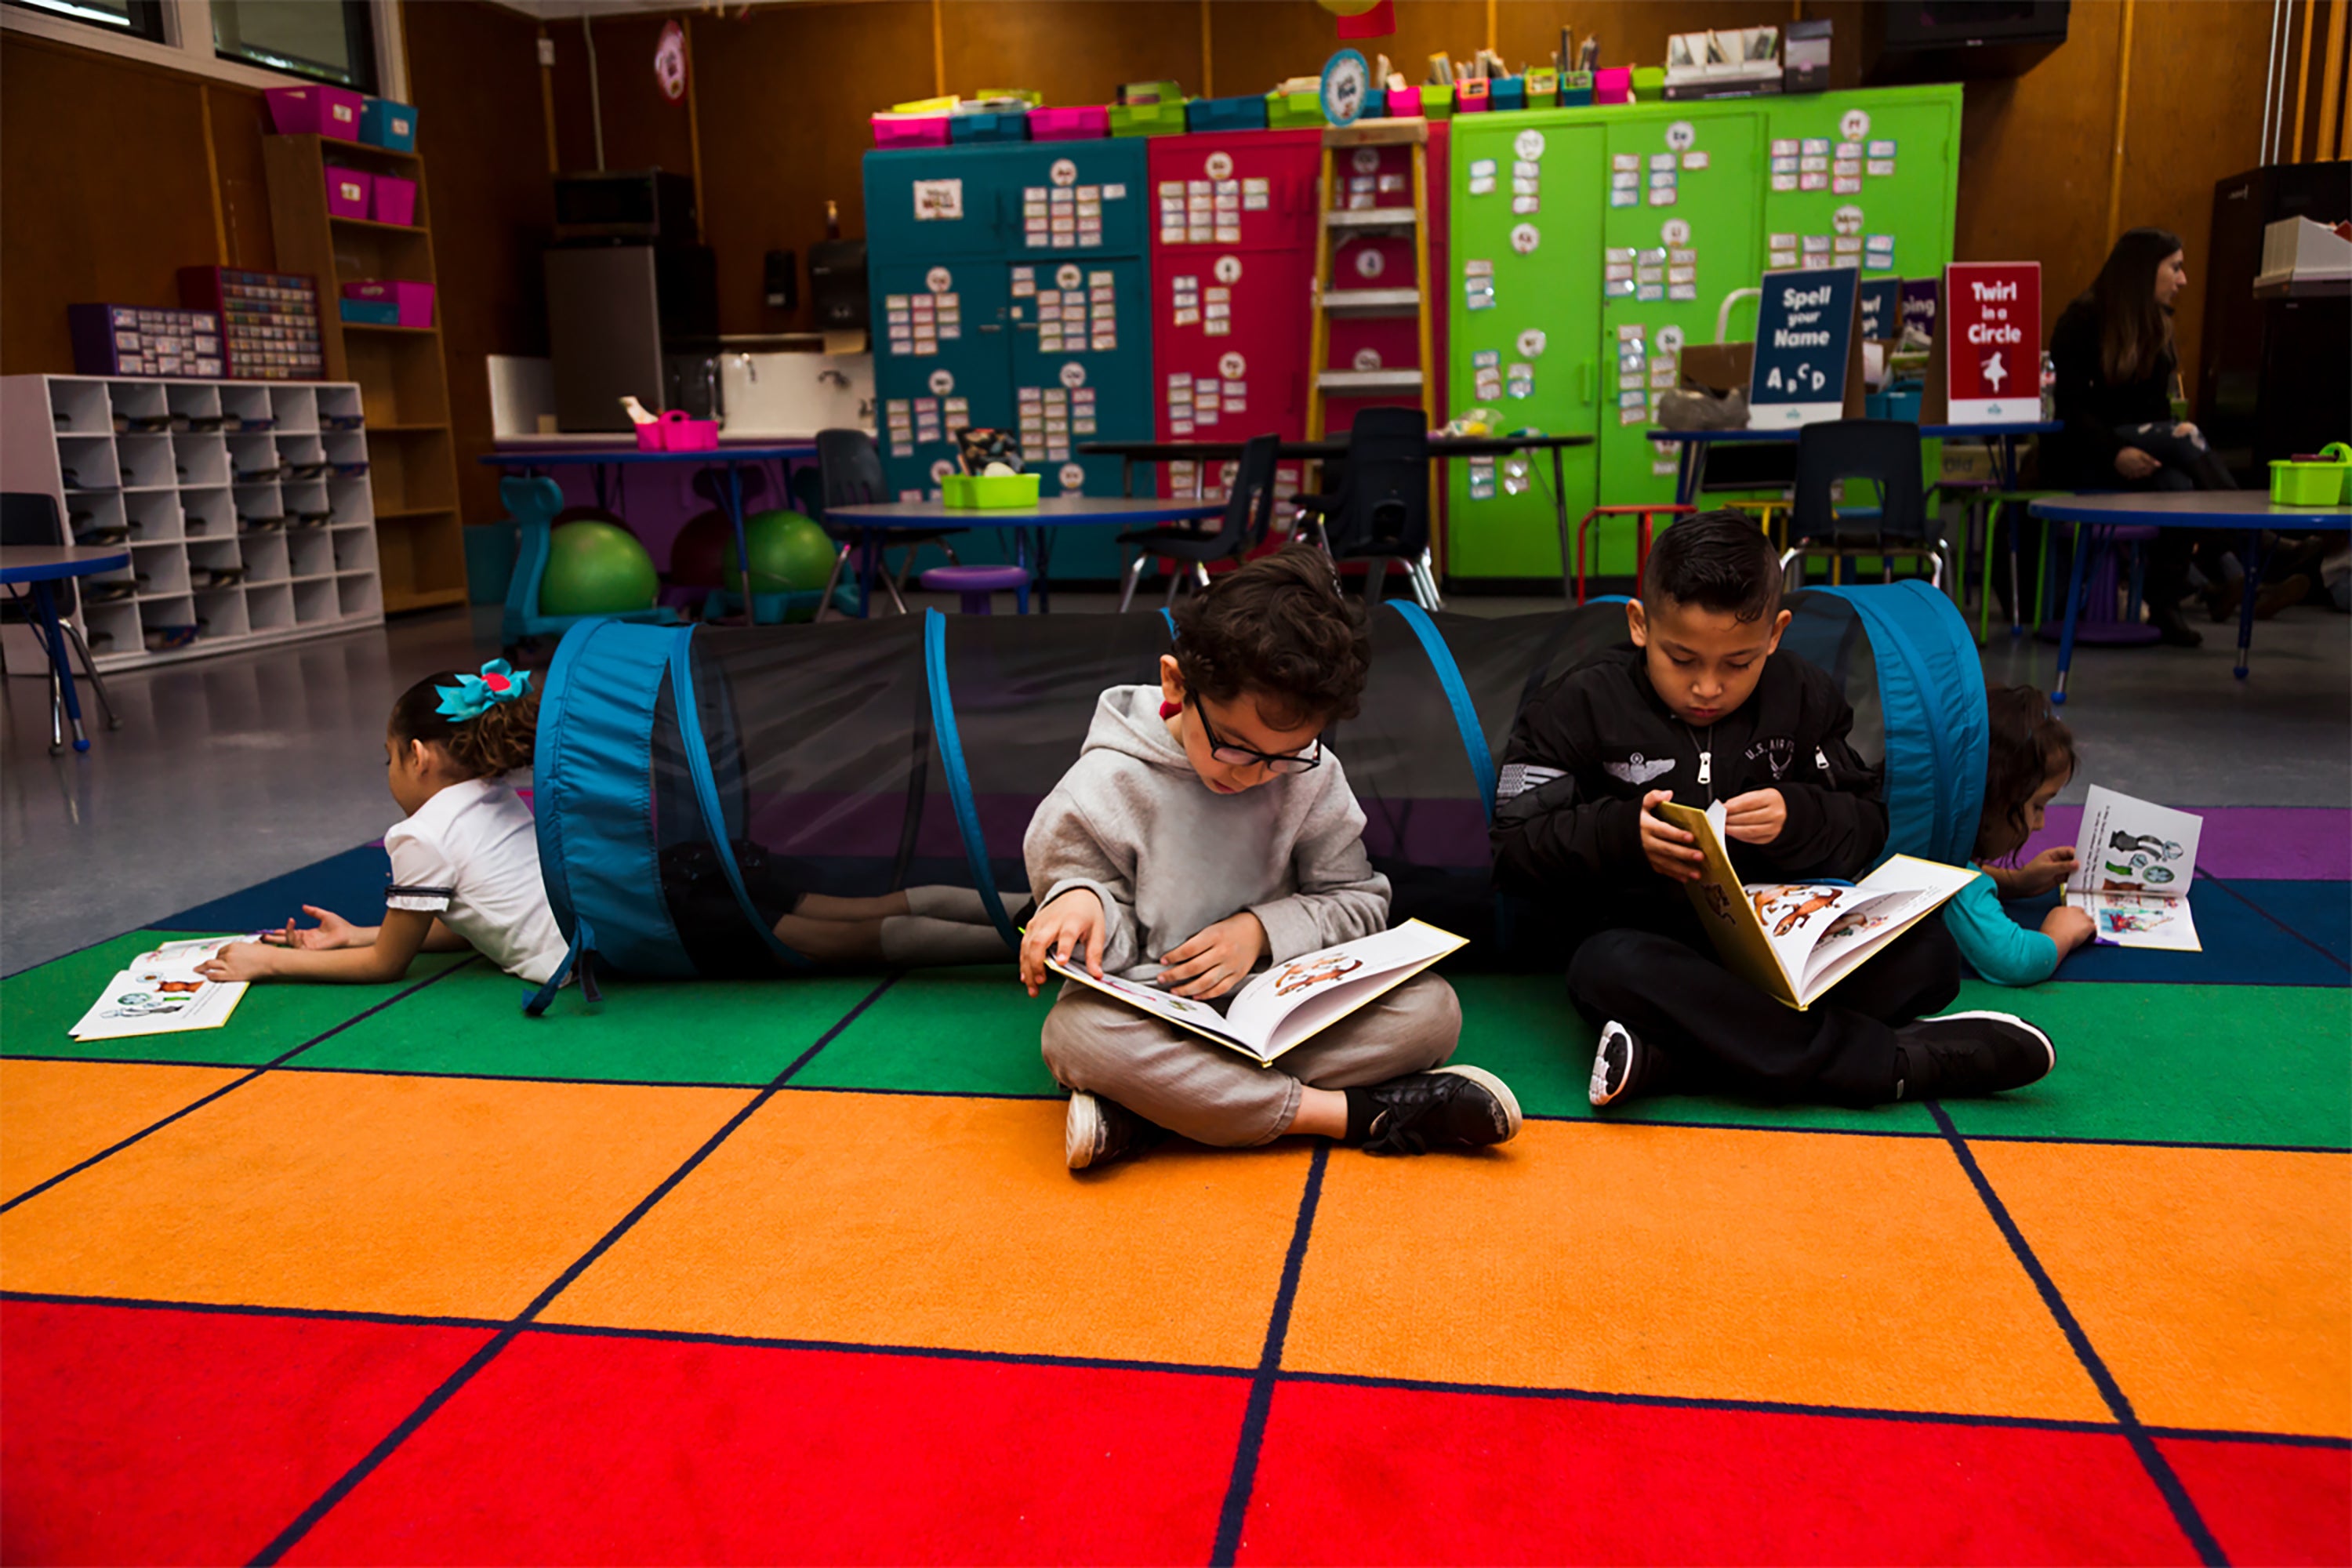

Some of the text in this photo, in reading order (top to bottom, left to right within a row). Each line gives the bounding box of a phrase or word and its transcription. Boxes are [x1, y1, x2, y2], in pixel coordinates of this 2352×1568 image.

[1784, 285, 1831, 310] Spell
[1971, 280, 2017, 301] Twirl
[1788, 311, 1821, 328] your
[1981, 304, 2008, 321] in a
[1774, 328, 1830, 348] Name
[1968, 323, 2022, 344] Circle
[1767, 363, 1825, 394] A B C D
[1744, 742, 1769, 760] U.S.
[1769, 739, 1784, 750] AIR
